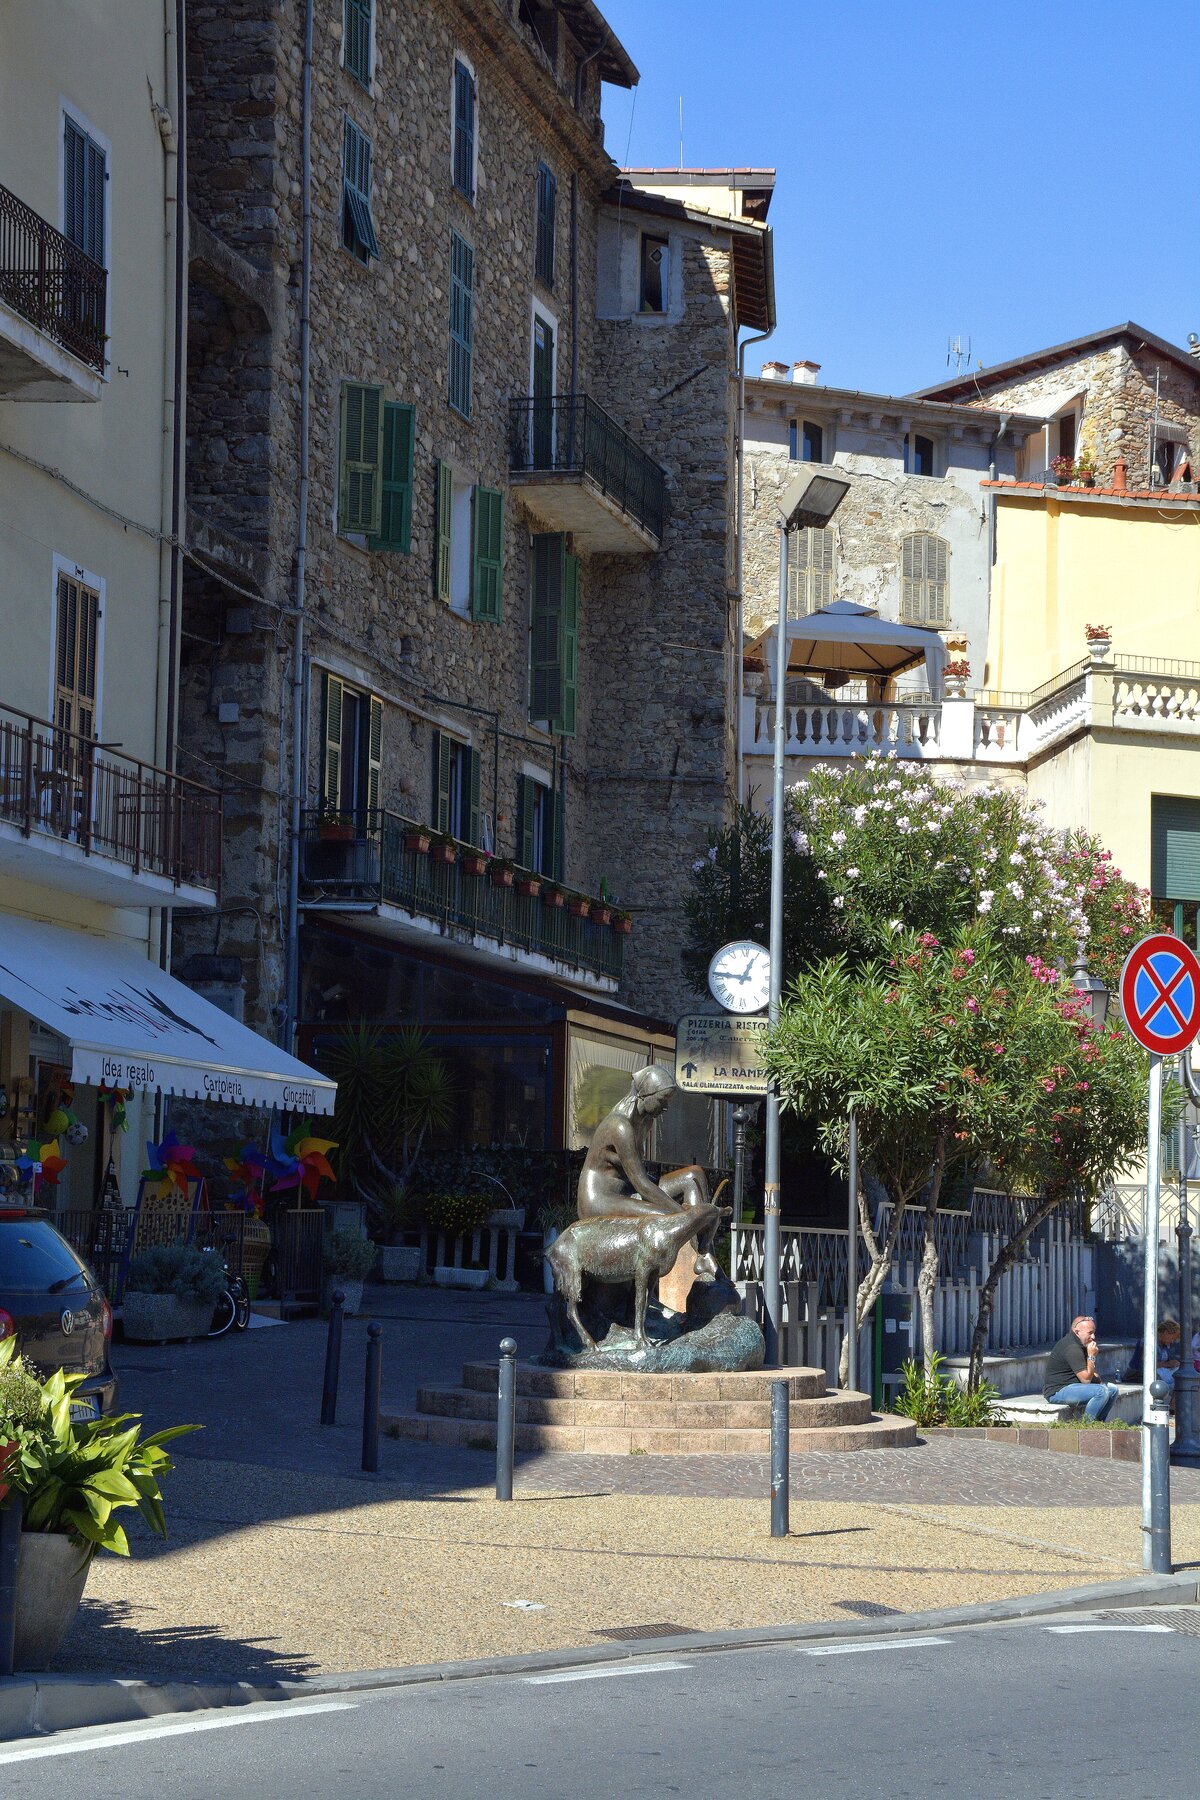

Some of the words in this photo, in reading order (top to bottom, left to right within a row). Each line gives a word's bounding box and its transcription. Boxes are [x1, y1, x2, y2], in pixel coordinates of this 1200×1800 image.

[688, 1019, 731, 1029] PIZZERIA
[102, 1057, 121, 1078] Idea
[126, 1063, 154, 1085] regalo
[713, 1067, 727, 1077] LA
[203, 1074, 242, 1096] Cartoleria
[700, 1082, 744, 1090] CLIMATIZZATA
[282, 1086, 316, 1105] Giocattoli
